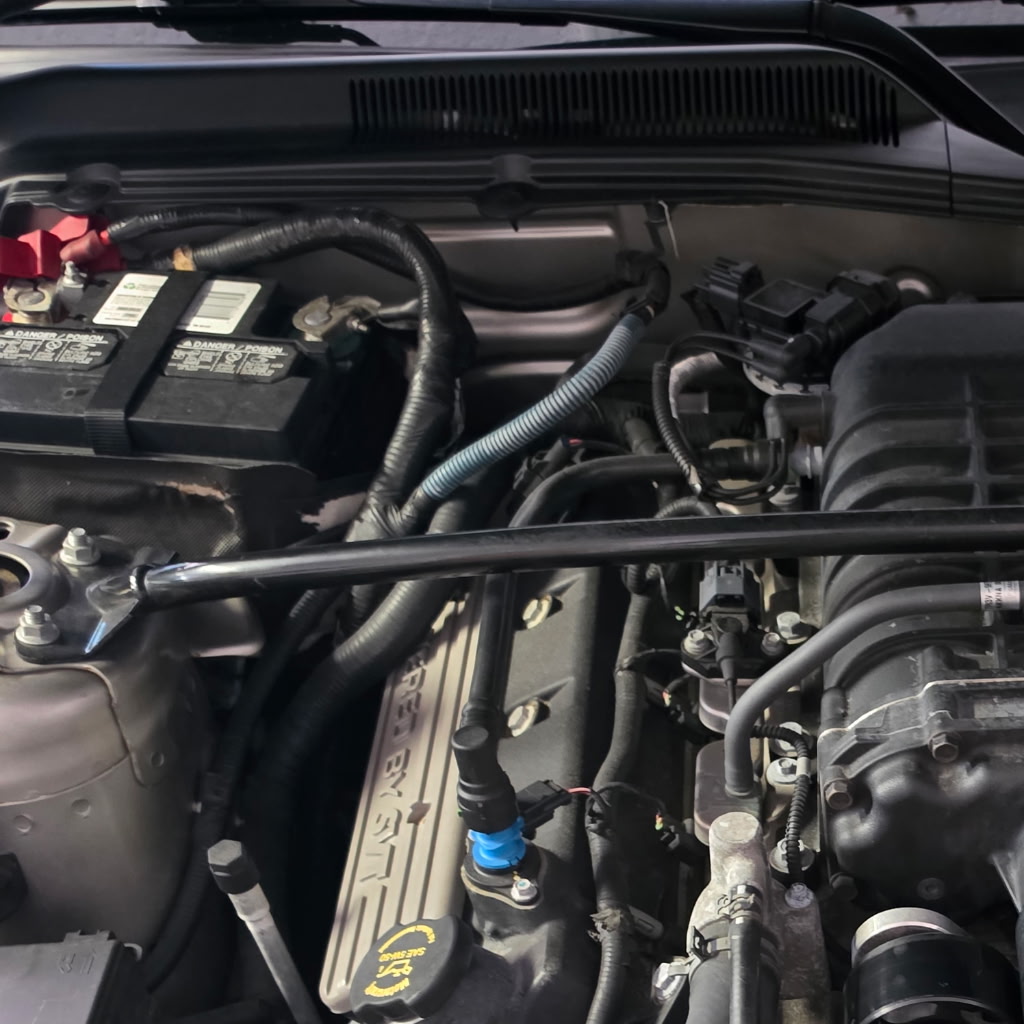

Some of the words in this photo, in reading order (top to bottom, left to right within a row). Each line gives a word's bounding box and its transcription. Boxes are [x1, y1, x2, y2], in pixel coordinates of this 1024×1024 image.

[15, 330, 58, 339] DANGER
[65, 333, 105, 342] POISON
[194, 341, 237, 350] DANGER
[244, 345, 284, 353] POISON
